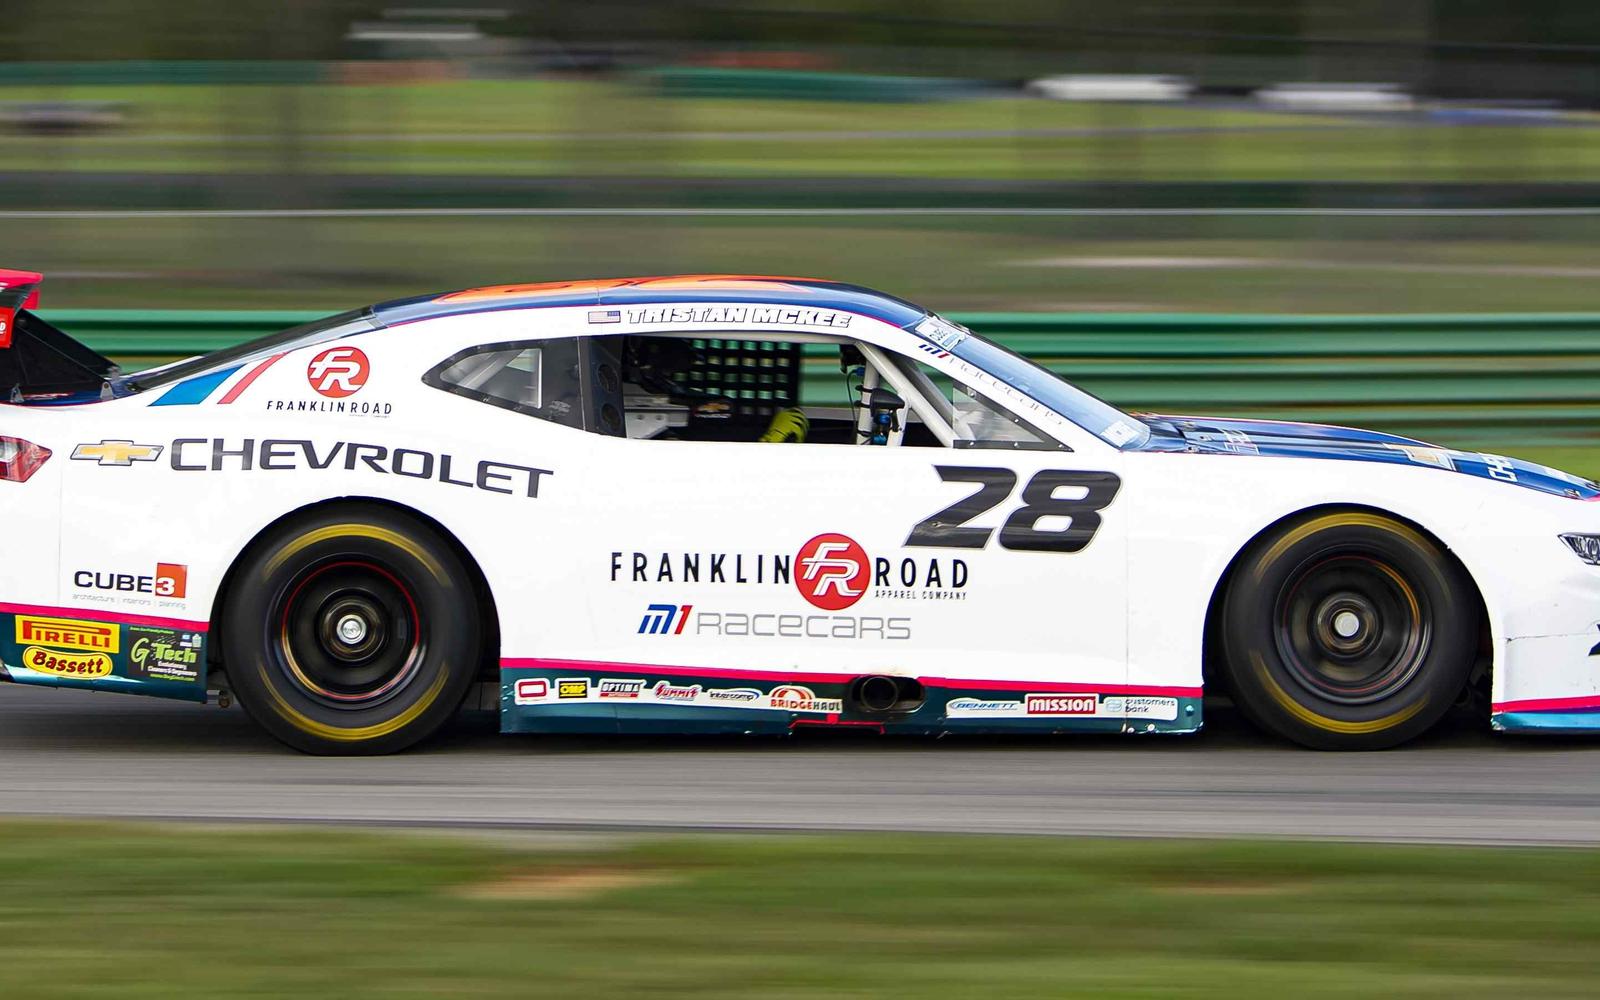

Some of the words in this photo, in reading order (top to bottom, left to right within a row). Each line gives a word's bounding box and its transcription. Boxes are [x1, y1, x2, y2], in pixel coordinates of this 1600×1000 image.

[626, 307, 748, 324] TRISTAN
[752, 308, 853, 328] MCKEE
[266, 400, 345, 413] FRANKLIN
[350, 401, 392, 415] ROAD
[169, 437, 554, 499] CHEVROLET
[901, 464, 1123, 555] 28
[610, 551, 791, 585] FRANKLIN
[875, 556, 969, 589] ROAD
[874, 590, 918, 600] APPAREL
[921, 591, 968, 601] COMPANY
[22, 620, 112, 649] PIRELLI
[32, 651, 104, 674] Bassett
[600, 682, 641, 692] OPTIMA
[770, 698, 841, 711] BRIDGEHAUL
[1125, 698, 1176, 706] customers
[1125, 704, 1150, 713] bank
